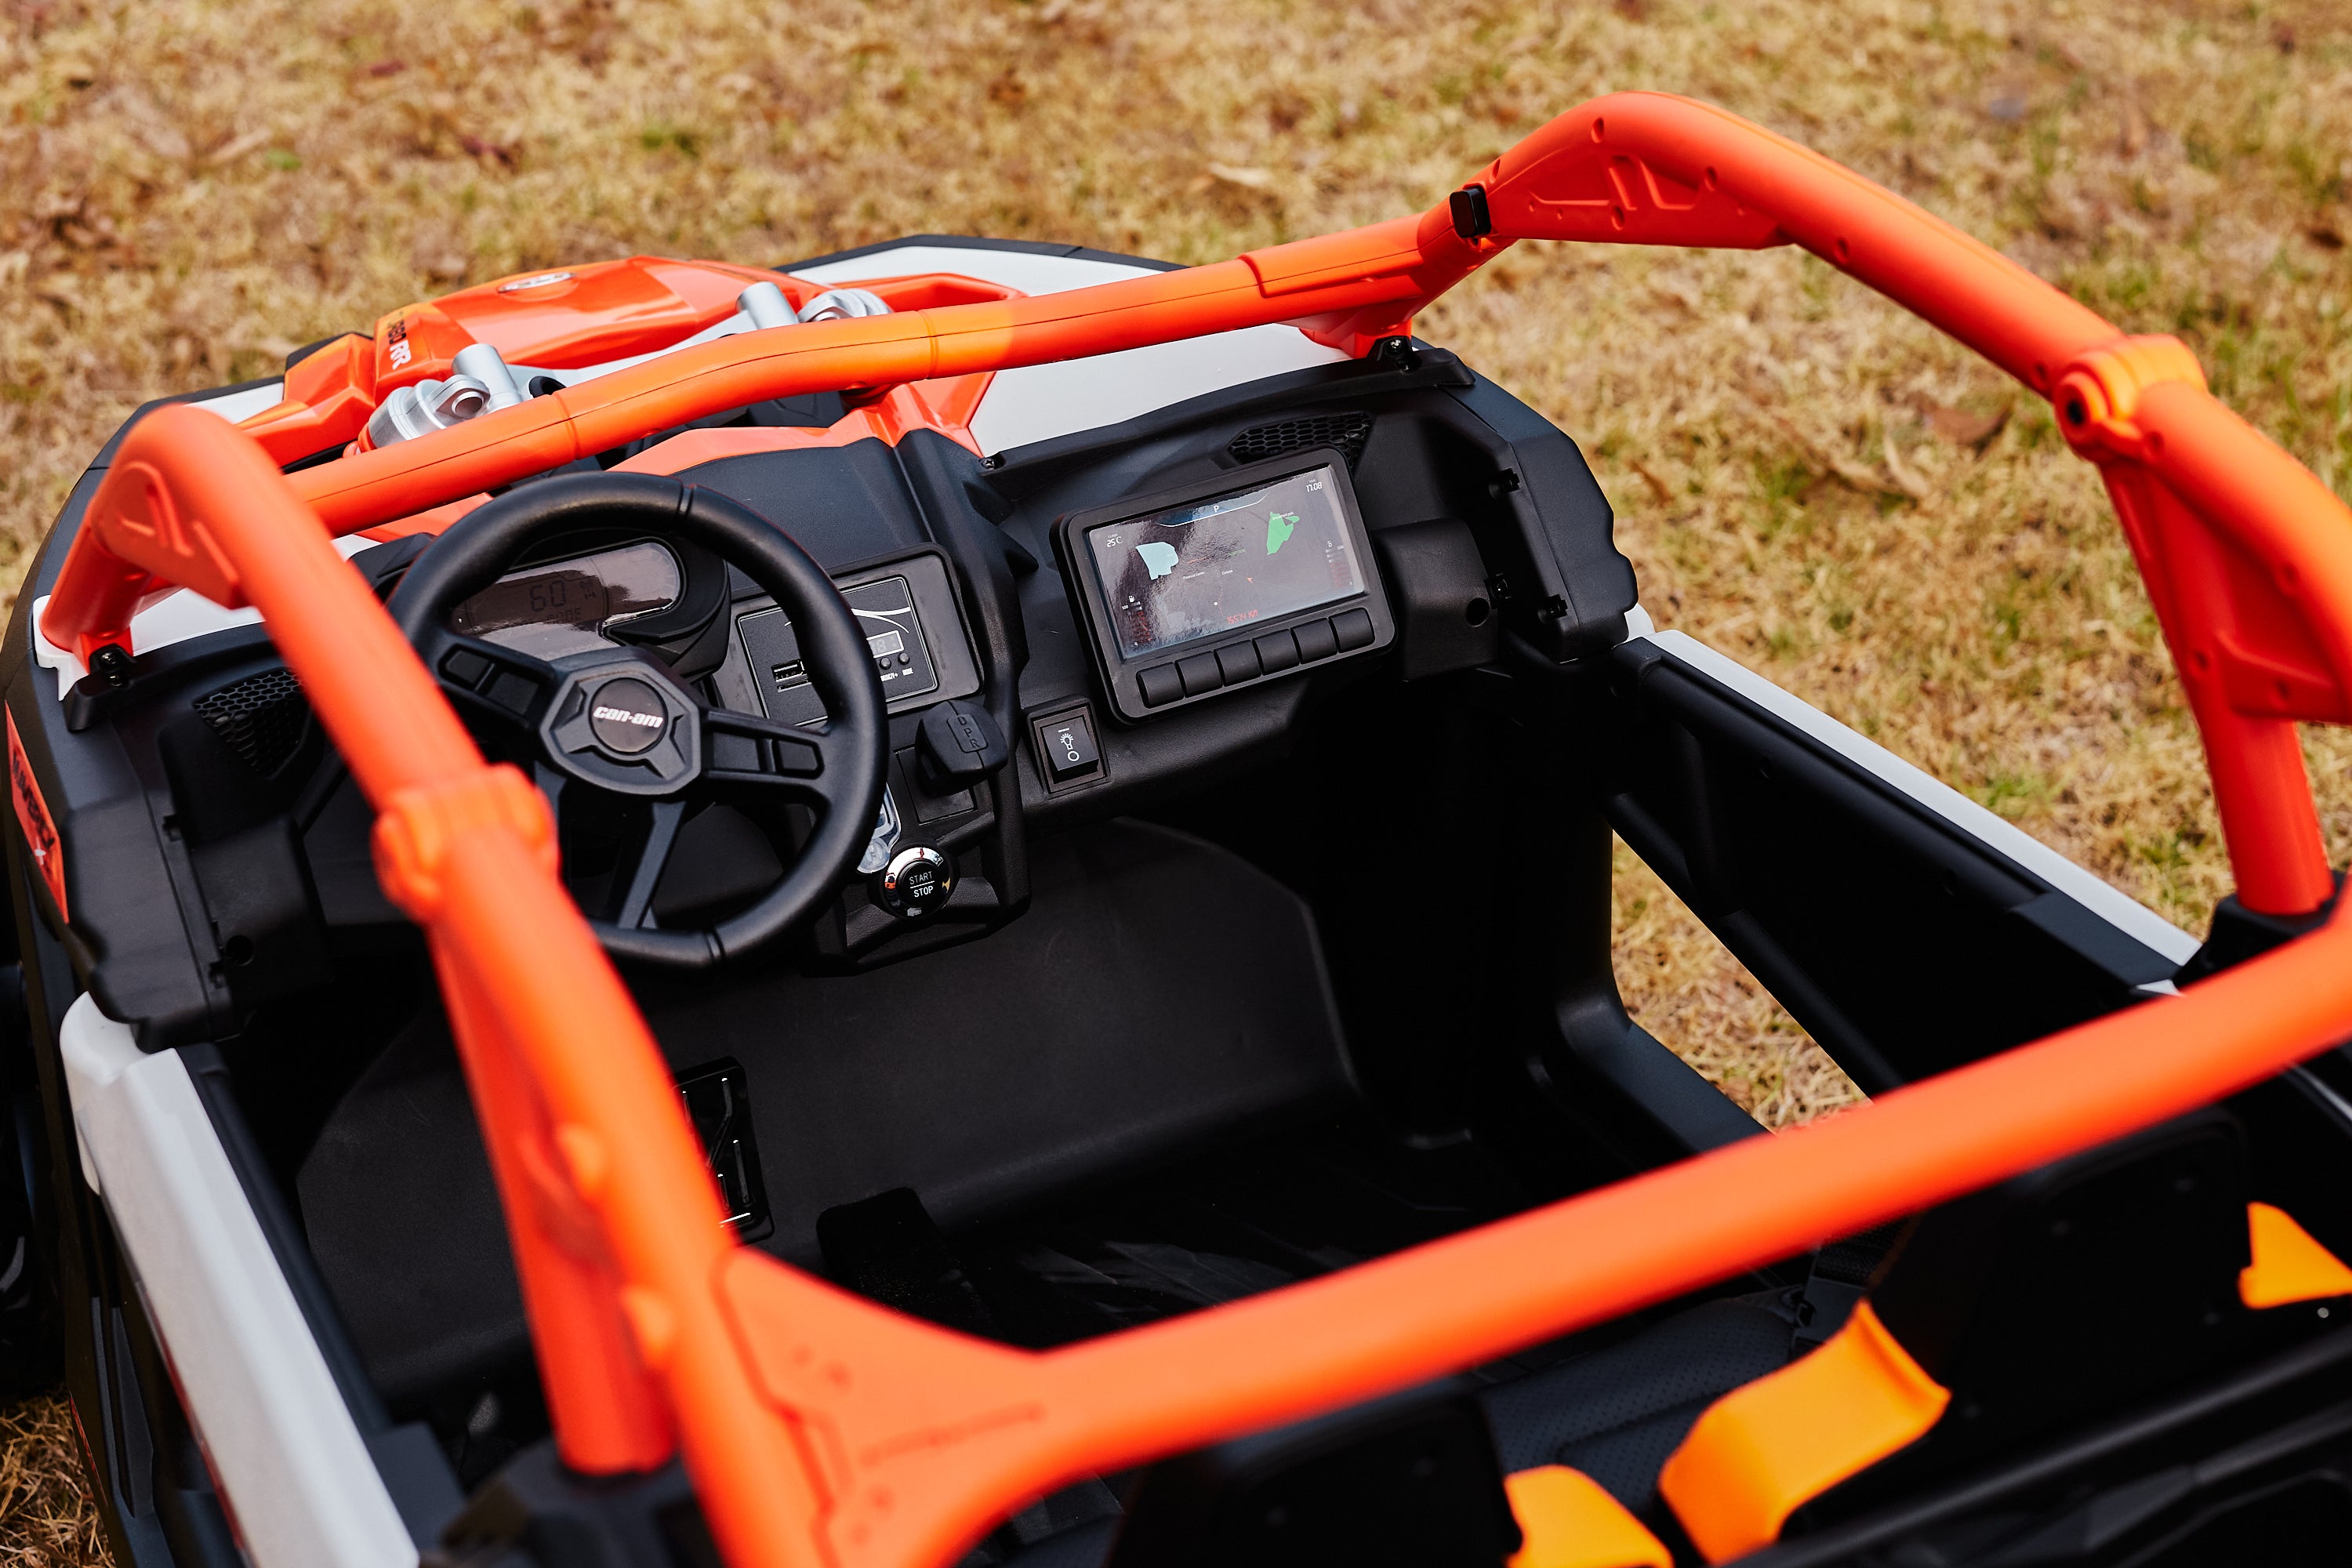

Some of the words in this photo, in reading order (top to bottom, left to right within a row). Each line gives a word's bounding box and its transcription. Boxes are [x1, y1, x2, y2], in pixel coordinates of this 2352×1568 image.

[389, 339, 412, 370] RR
[1213, 505, 1220, 514] P
[529, 580, 566, 612] 60
[957, 717, 967, 726] D
[964, 728, 972, 738] P
[969, 739, 980, 749] R
[909, 871, 932, 885] START
[913, 885, 934, 898] STOP
